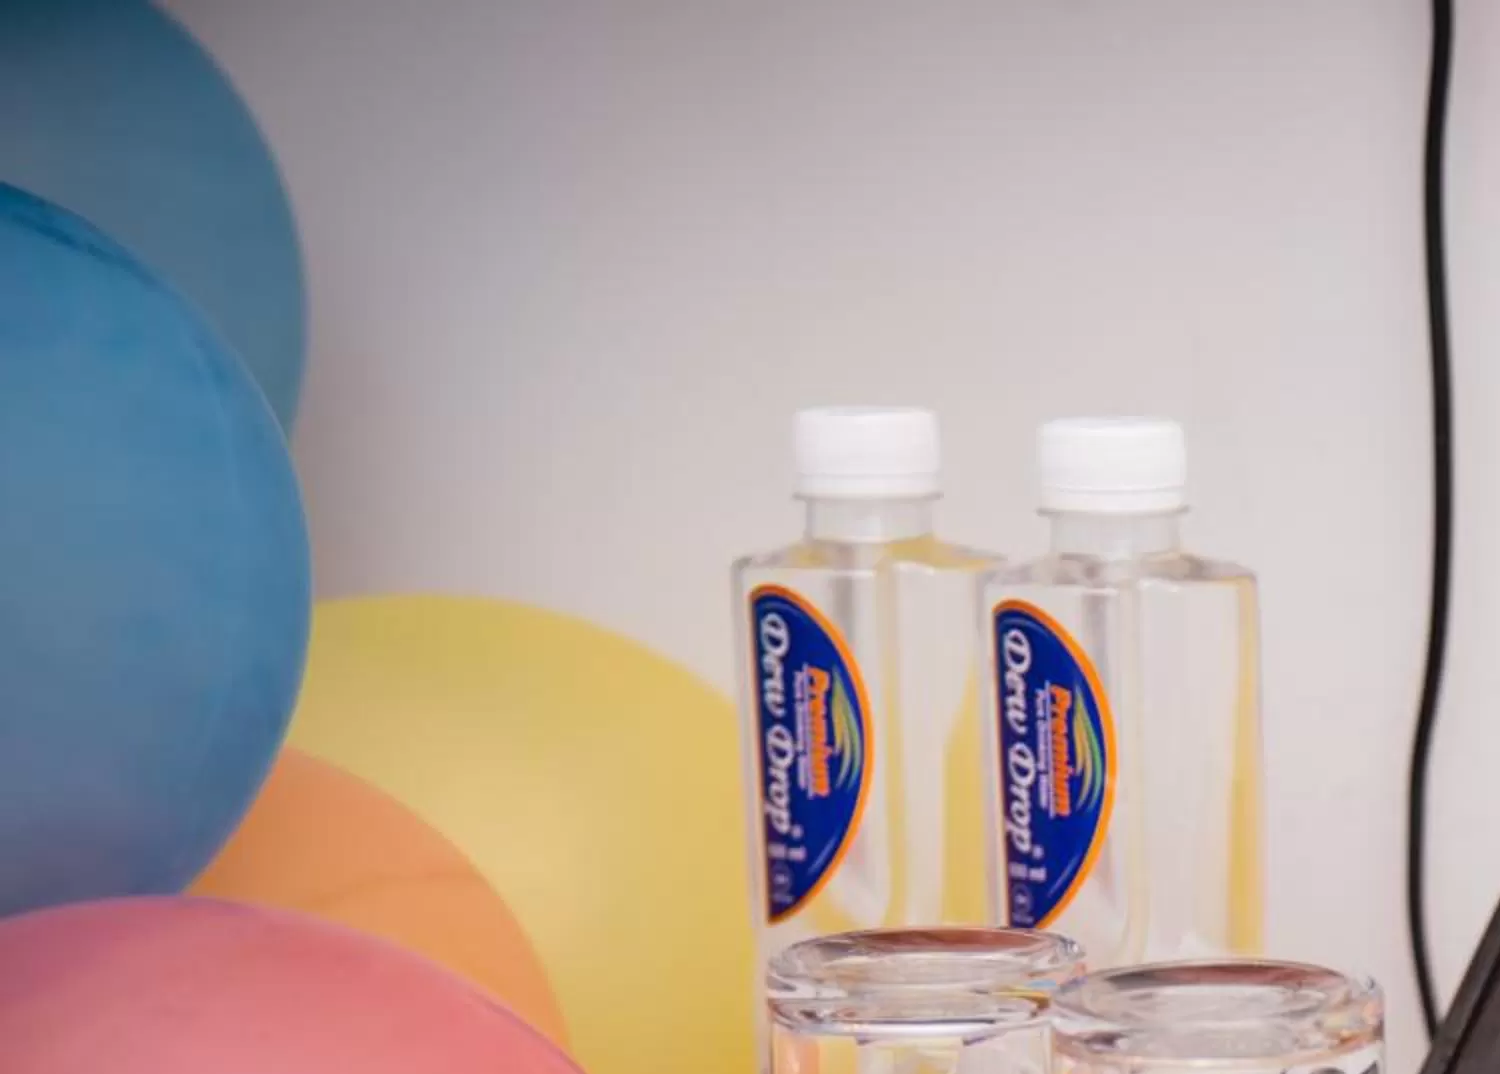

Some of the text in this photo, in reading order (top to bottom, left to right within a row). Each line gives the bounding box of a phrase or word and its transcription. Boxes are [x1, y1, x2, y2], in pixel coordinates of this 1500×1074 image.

[760, 613, 795, 835] Dew Drop
[807, 667, 832, 797] Premium
[1002, 628, 1038, 856] Dew Drop
[1049, 684, 1075, 817] Premium
